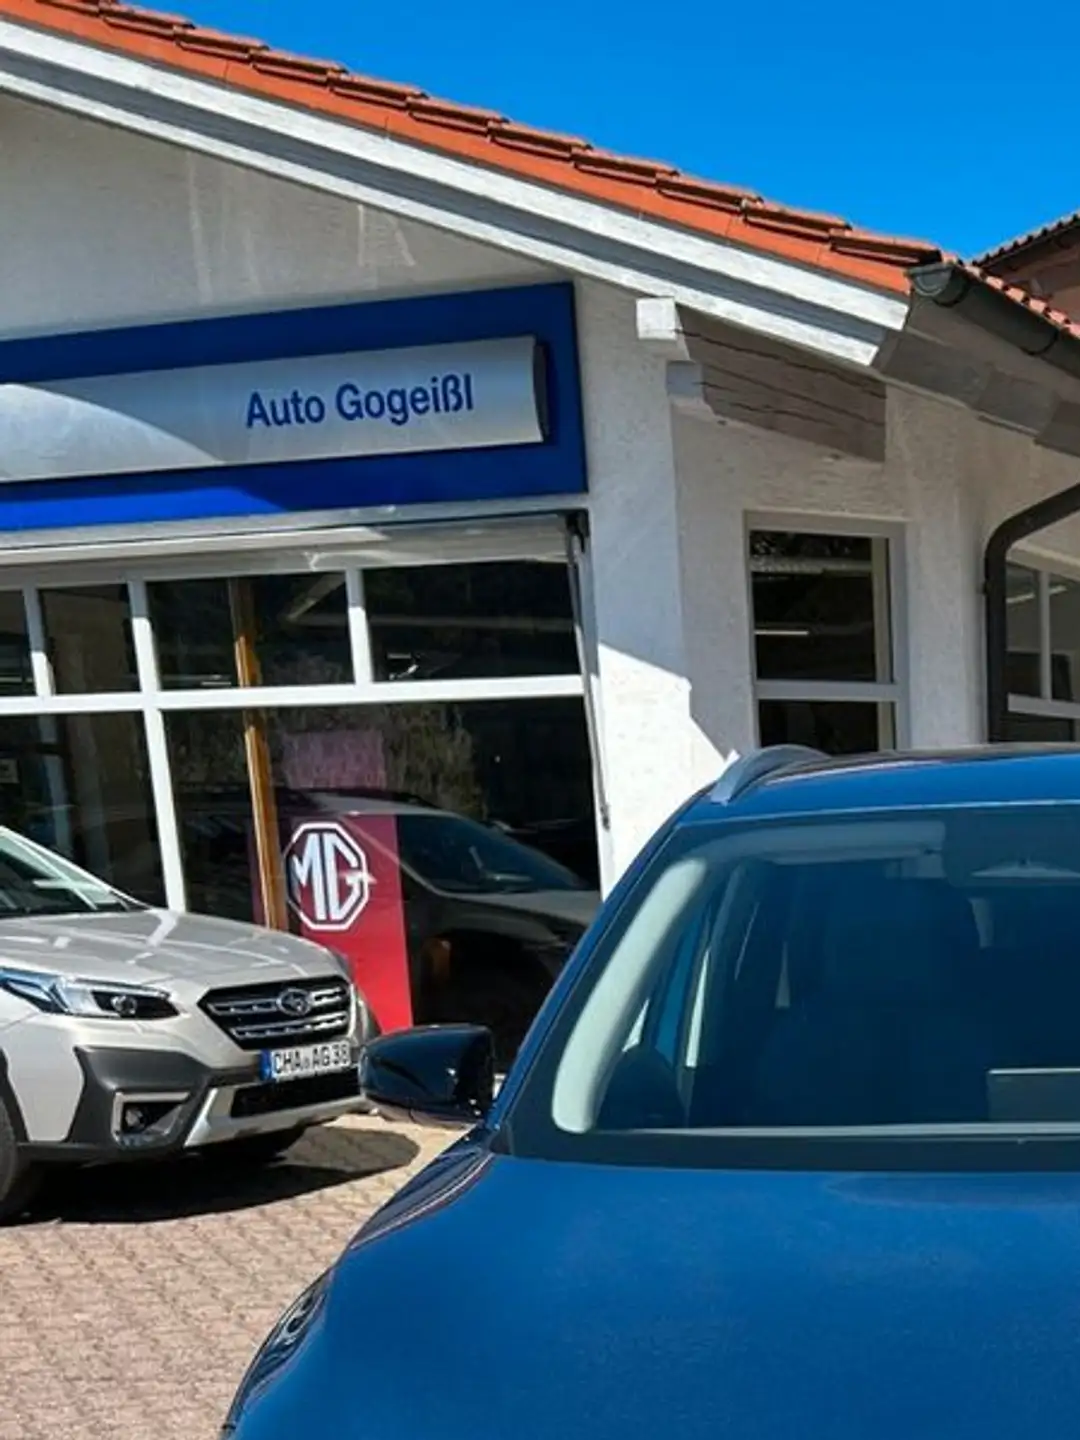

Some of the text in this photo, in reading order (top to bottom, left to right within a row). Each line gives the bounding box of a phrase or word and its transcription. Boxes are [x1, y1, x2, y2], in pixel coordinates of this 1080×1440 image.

[246, 373, 473, 428] Auto Gogeißl
[290, 828, 369, 923] MG
